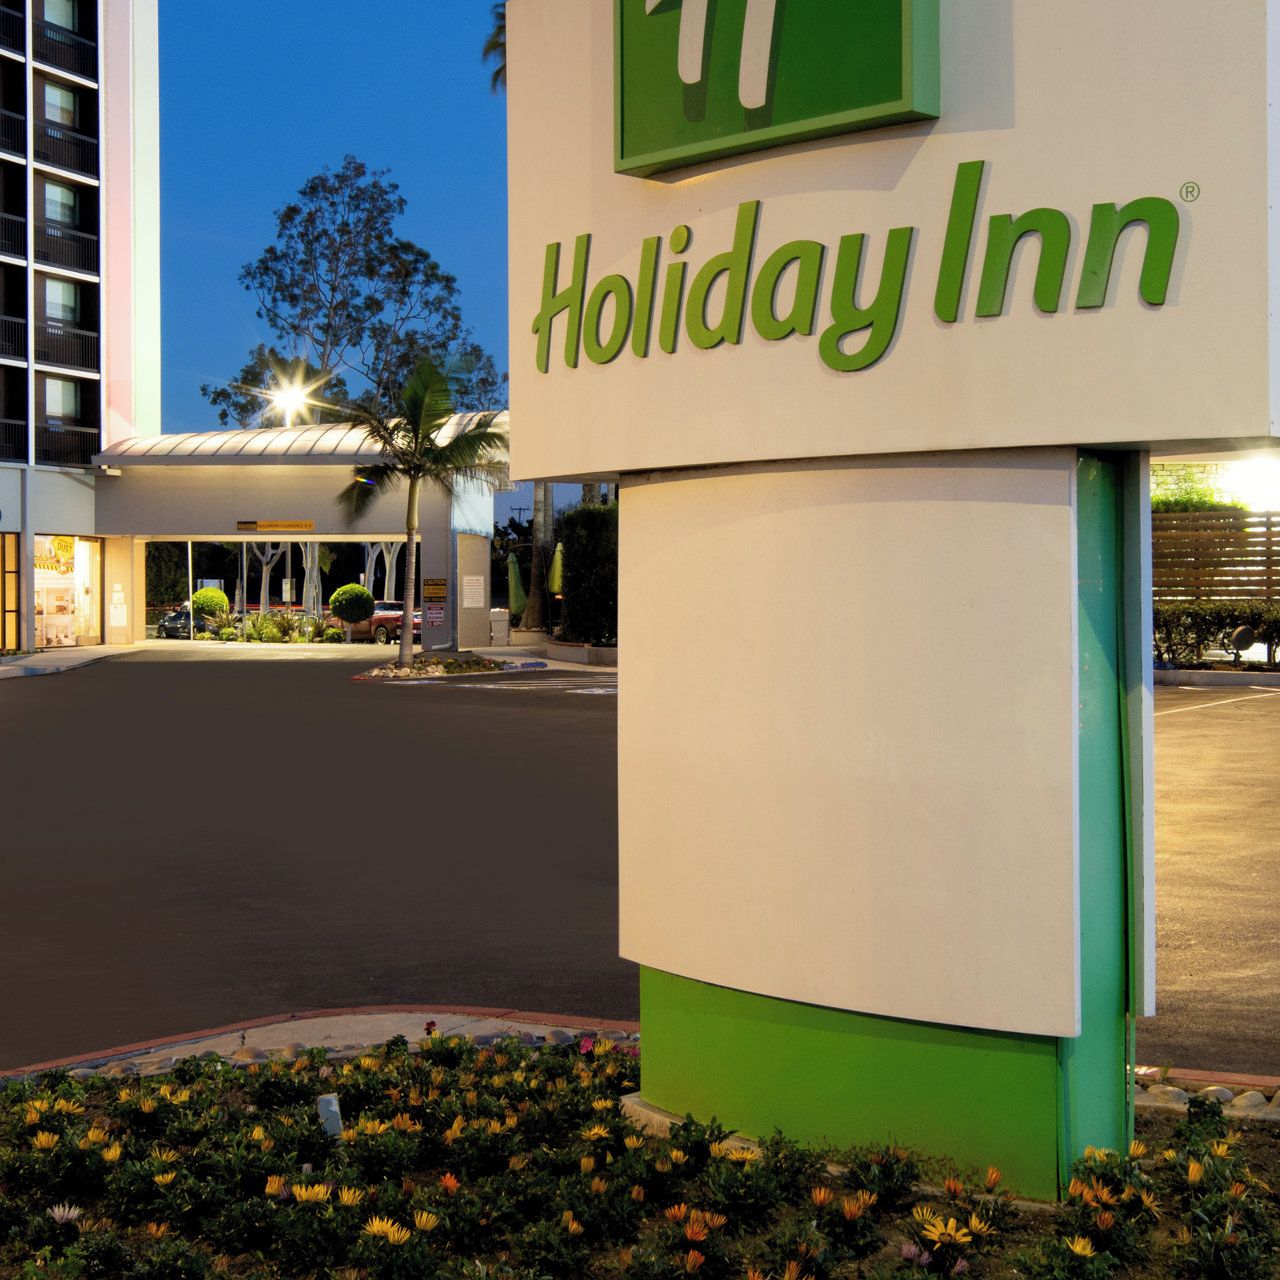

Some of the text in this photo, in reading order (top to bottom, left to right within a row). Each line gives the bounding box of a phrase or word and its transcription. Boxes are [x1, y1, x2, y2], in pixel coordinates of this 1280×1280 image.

[532, 199, 915, 374] Holiday
[933, 159, 1180, 323] Inn
[56, 541, 73, 554] DUST
